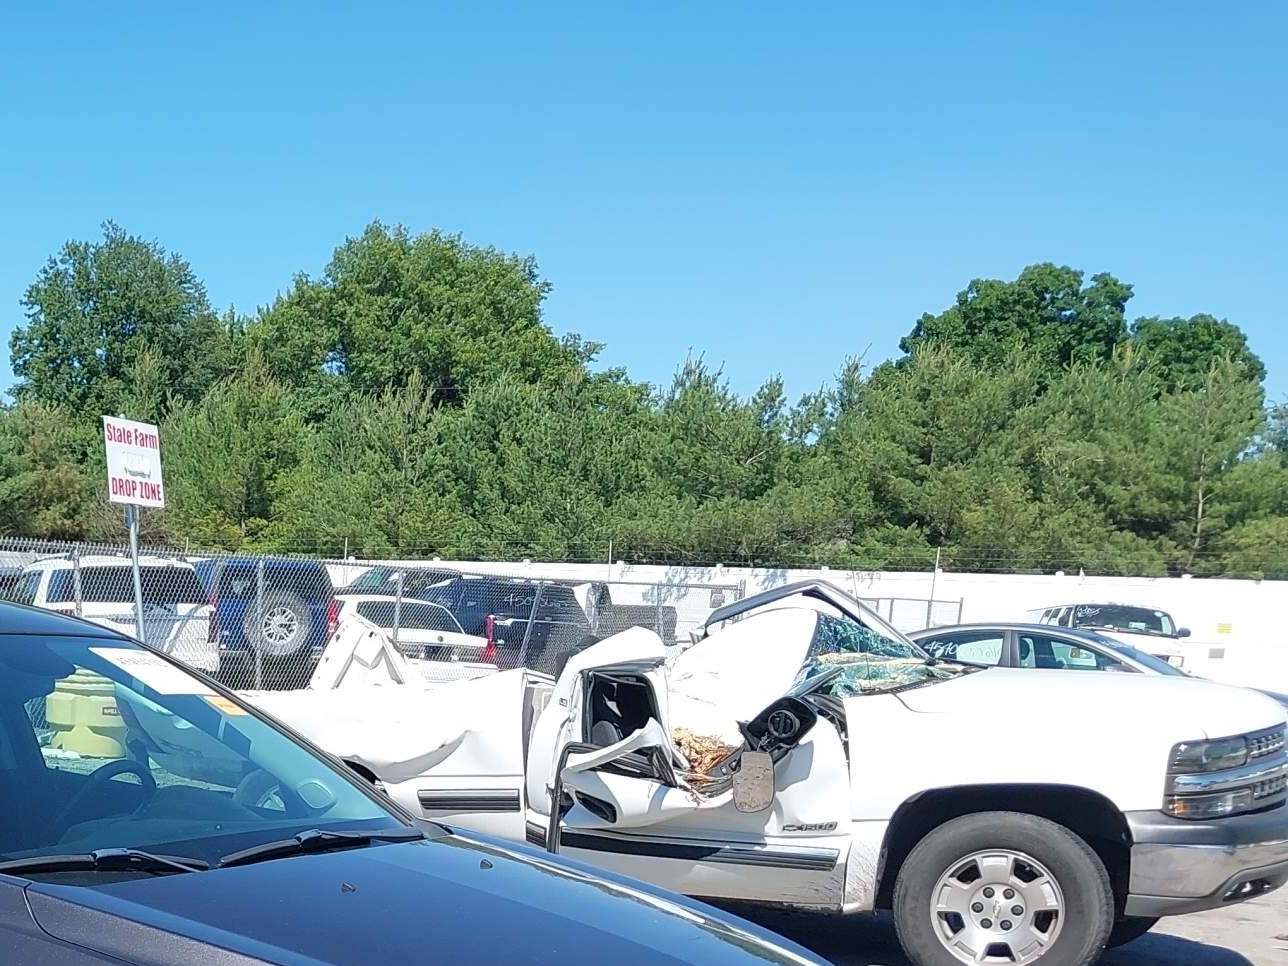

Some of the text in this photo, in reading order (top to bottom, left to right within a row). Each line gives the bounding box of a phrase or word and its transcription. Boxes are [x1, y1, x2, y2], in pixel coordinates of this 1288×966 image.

[106, 423, 158, 449] State Farm
[112, 477, 162, 501] DROP ZONE
